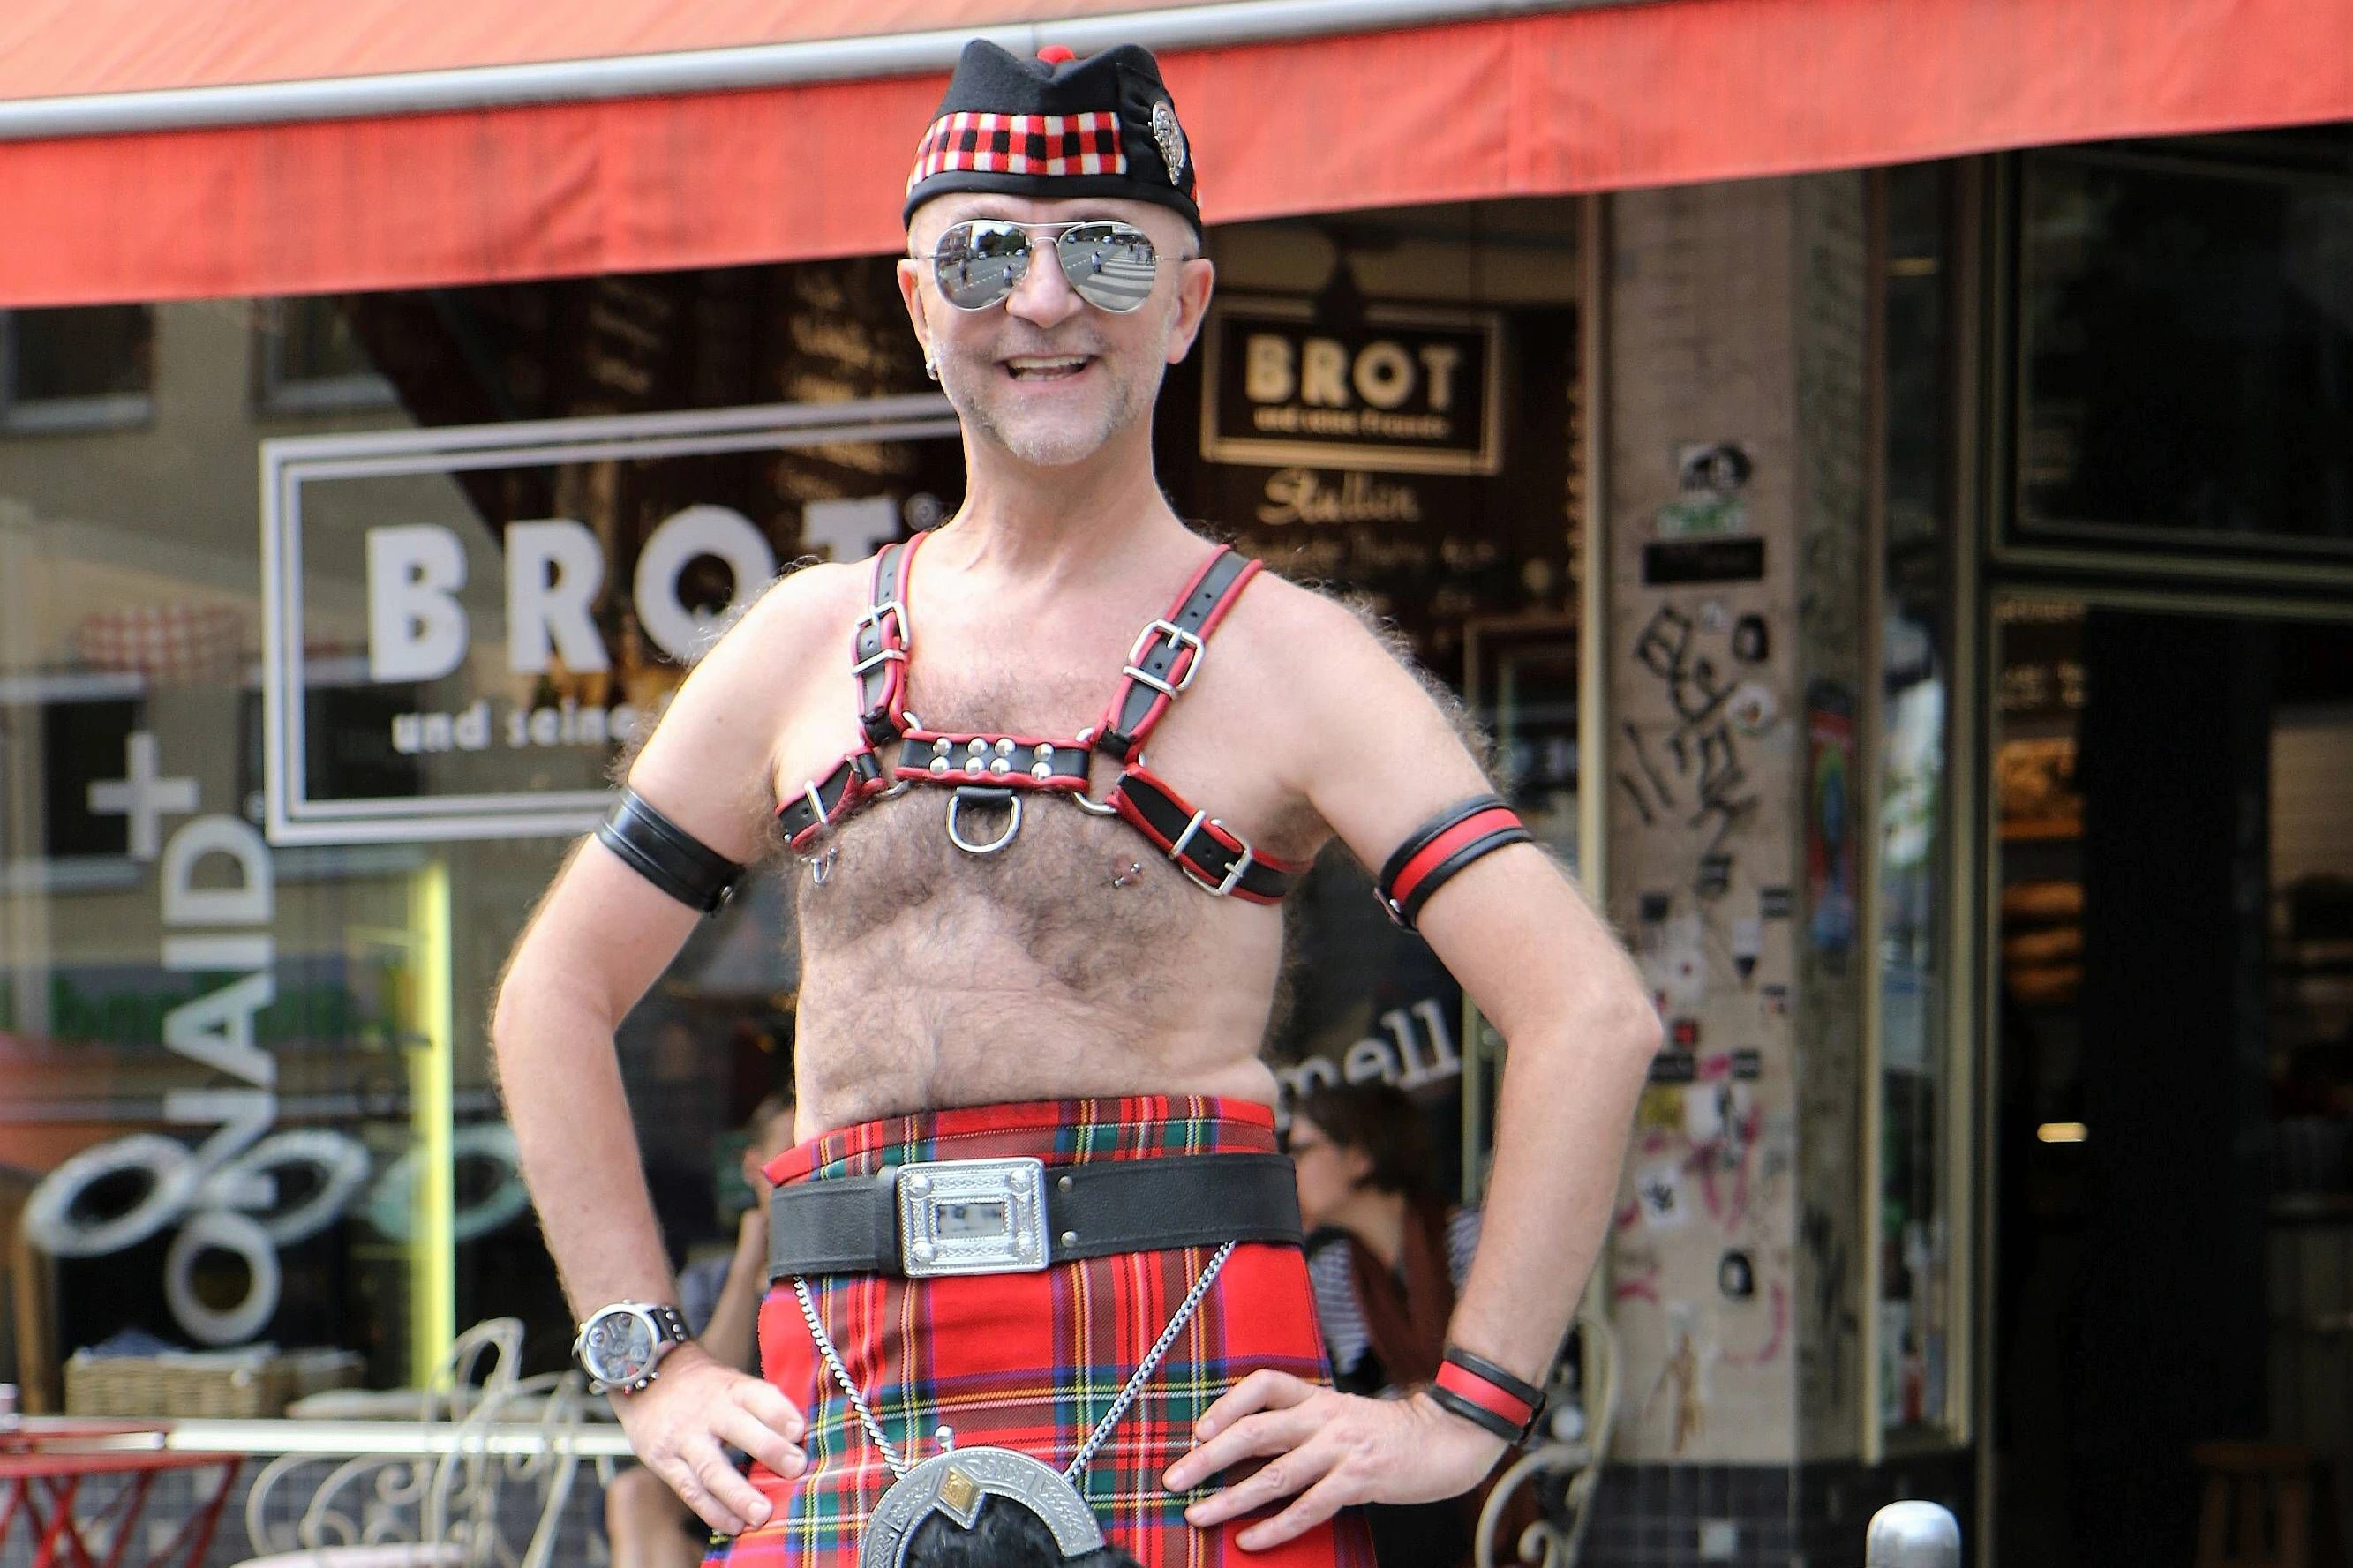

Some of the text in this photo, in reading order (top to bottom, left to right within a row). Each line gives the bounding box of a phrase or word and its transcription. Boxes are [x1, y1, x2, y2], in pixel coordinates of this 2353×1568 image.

[1244, 333, 1462, 410] BROT
[366, 496, 900, 683] BROT
[391, 699, 491, 754] und
